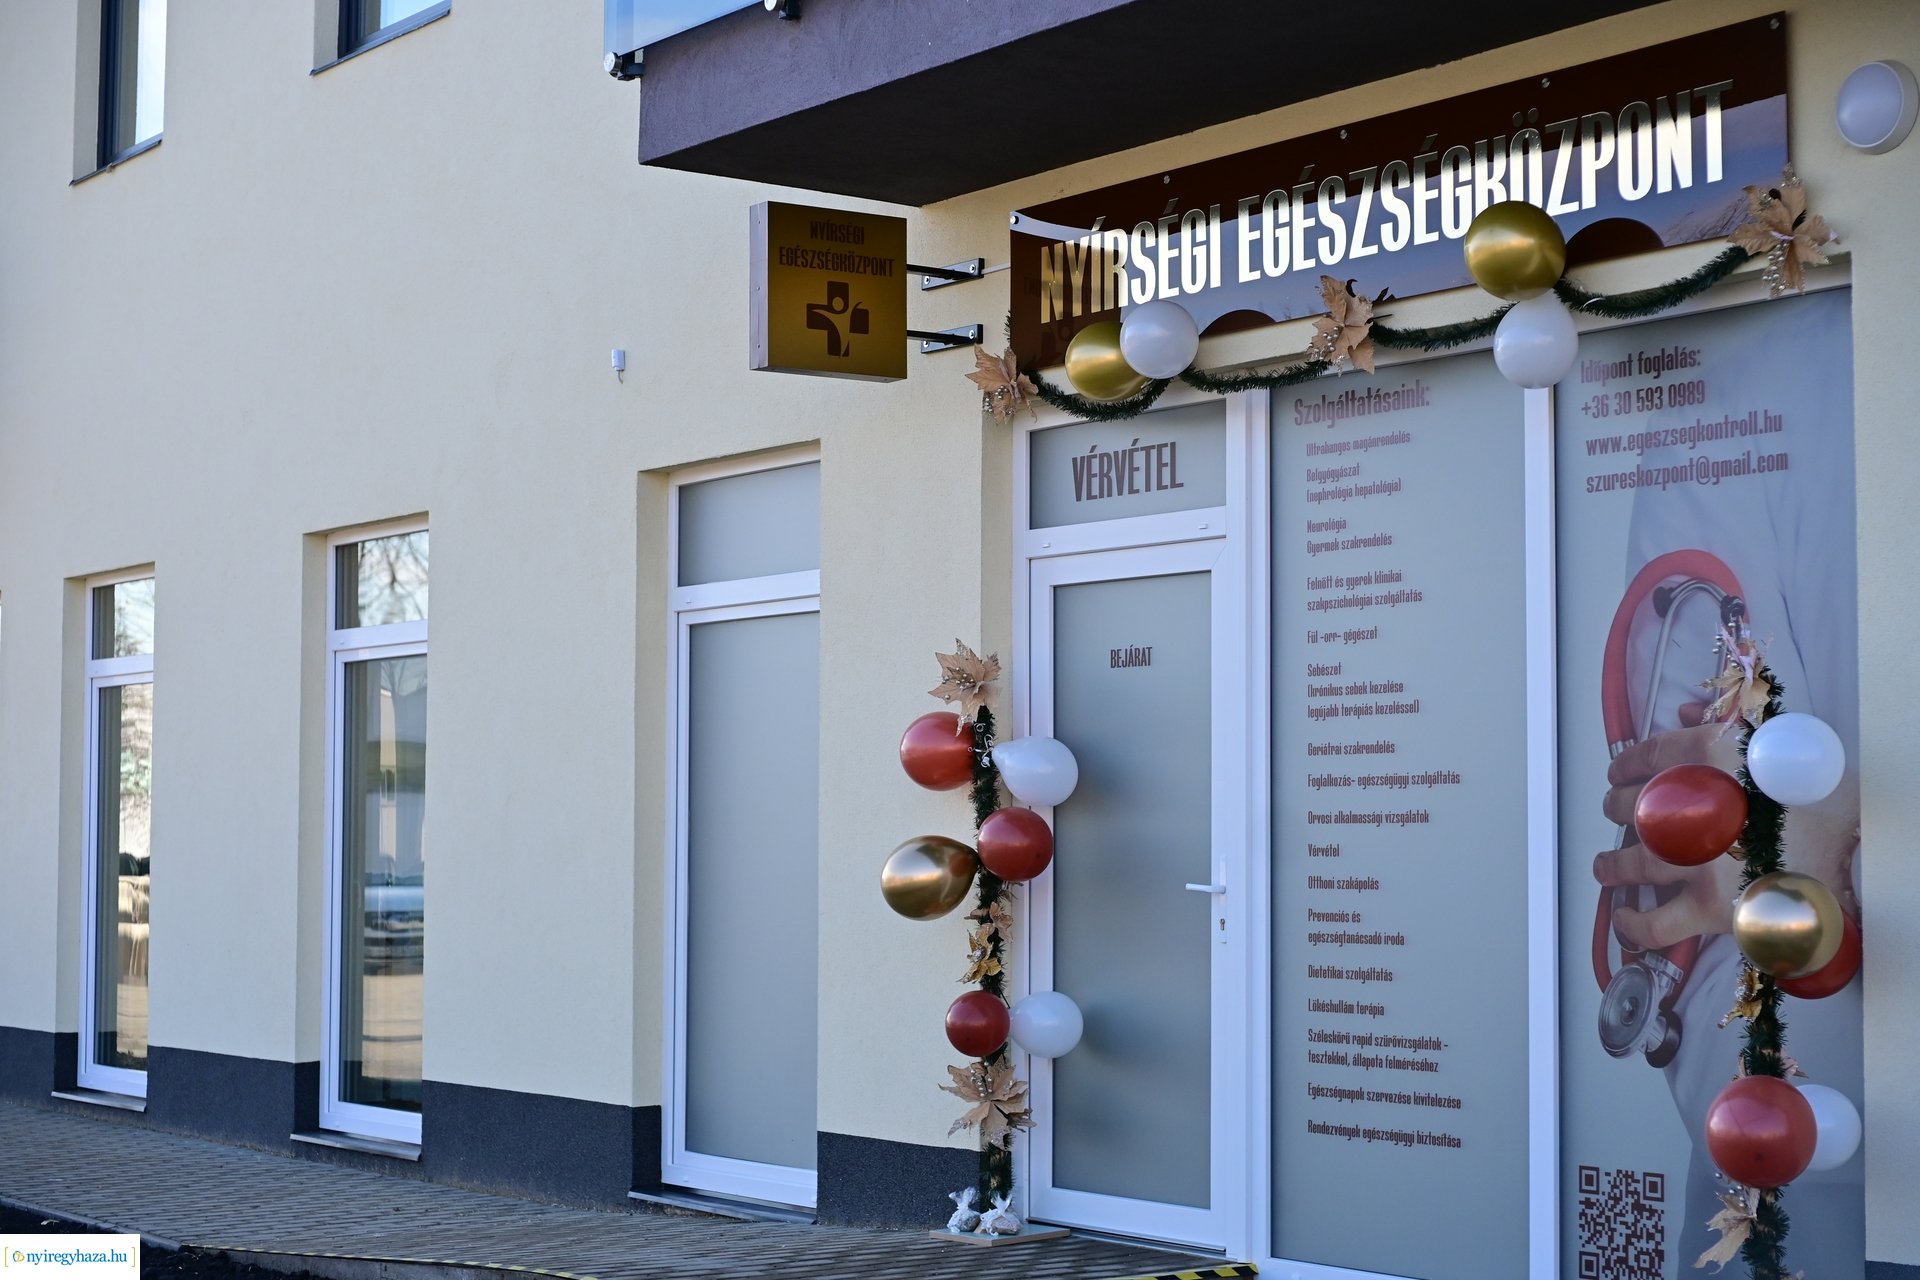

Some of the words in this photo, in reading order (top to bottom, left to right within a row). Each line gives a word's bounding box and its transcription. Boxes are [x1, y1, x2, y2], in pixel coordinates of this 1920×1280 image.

[1041, 198, 1221, 324] NYÍRSÉGI
[1238, 79, 1734, 284] EGÉSZSÉGKÖZPONT
[810, 220, 864, 245] NYÍRSÉGI
[779, 245, 895, 276] EGÉSZSÉGKÖZPONT
[1581, 353, 1633, 387] Időpont
[1637, 346, 1701, 379] foglalás:
[1294, 379, 1430, 428] Szolgáltatásaink:
[1581, 394, 1609, 419] +36
[1614, 390, 1631, 415] 30
[1636, 386, 1664, 412] 593
[1668, 380, 1705, 408] 0989
[1306, 440, 1350, 456] Ultrahangos
[1353, 430, 1410, 452] magánrendelés
[1586, 409, 1783, 456] www.egeszsegkontroll.hu
[1072, 438, 1184, 502] VÉRVÉTEL
[1307, 463, 1360, 484] Belgyógyászat
[1587, 451, 1789, 493] szureskozpont@gmail.com
[1355, 478, 1401, 497] hepatológia)
[1307, 517, 1346, 534] Neurológia
[1307, 535, 1339, 557] Gyermek
[1342, 533, 1392, 549] szakrendelés
[1335, 578, 1343, 588] és
[1346, 572, 1372, 590] gyerek
[1375, 570, 1402, 584] klinikai
[1307, 593, 1372, 613] szakpszichológiai
[1375, 589, 1422, 607] szolgáltatás
[1307, 630, 1318, 643] Fül
[1320, 633, 1341, 642] -orr-
[1344, 626, 1377, 644] gégészet
[1111, 645, 1152, 668] BEJÁRAT
[1308, 662, 1341, 677] Sebészet
[1308, 682, 1343, 698] (krónikus
[1345, 682, 1367, 695] sebek
[1370, 680, 1403, 694] kezelése
[1308, 703, 1339, 721] legújabb
[1341, 702, 1373, 719] terápiás
[1375, 700, 1419, 715] kezeléssel)
[1308, 742, 1341, 756] Geriátrai
[1344, 741, 1395, 755] szakrendelés
[1308, 774, 1355, 790] Foglalkozás-
[1358, 773, 1409, 789] egészségügyi
[1412, 771, 1460, 789] szolgáltatás
[1308, 811, 1332, 824] Orvosi
[1334, 810, 1382, 827] alkalmassági
[1385, 810, 1429, 826] vizsgálatok
[1308, 844, 1339, 857] Vérvétel
[1308, 876, 1334, 889] Otthoni
[1337, 876, 1379, 893] szakápolás
[1308, 908, 1349, 922] Prevenciós
[1352, 911, 1360, 922] és
[1308, 931, 1381, 947] egészségtanácsadó
[1384, 933, 1404, 945] iroda
[1308, 965, 1343, 980] Dietetikai
[1346, 967, 1392, 984] szolgáltatás
[1308, 999, 1354, 1014] Lökéshullám
[1357, 1001, 1384, 1018] terápia
[1353, 1032, 1372, 1049] rapid
[1308, 1050, 1350, 1067] tesztekkel,
[1353, 1053, 1383, 1070] állapota
[1385, 1055, 1438, 1072] felméréséhez
[1308, 1082, 1364, 1103] Egészségnapok
[1367, 1089, 1411, 1105] szervezése
[1414, 1092, 1461, 1109] kivitelezése
[1308, 1120, 1360, 1141] Rendezvények
[1363, 1126, 1414, 1145] egészségügyi
[1417, 1131, 1461, 1148] biztosítása
